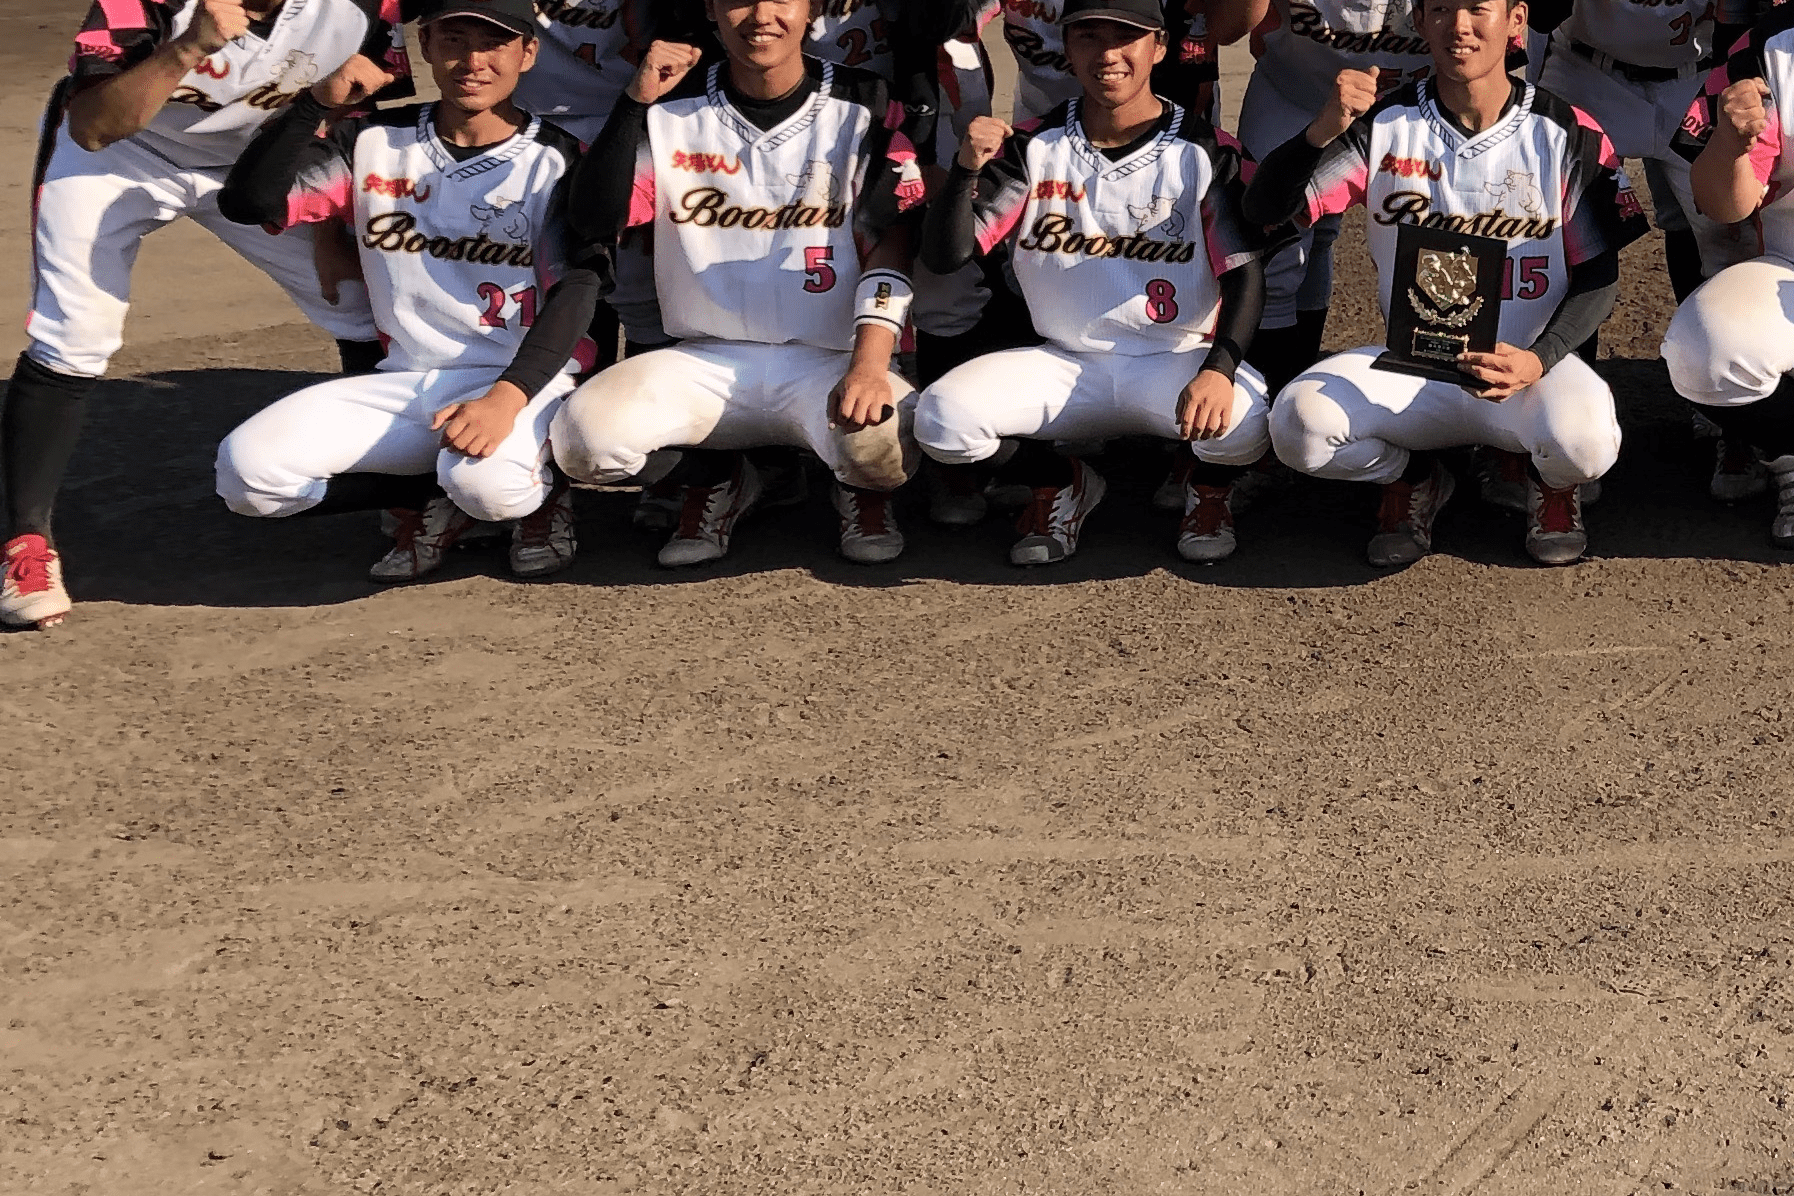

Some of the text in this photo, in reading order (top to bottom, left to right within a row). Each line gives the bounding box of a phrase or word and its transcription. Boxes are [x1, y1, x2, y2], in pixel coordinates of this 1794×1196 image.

[669, 186, 847, 230] Boostars
[1373, 189, 1559, 240] Boostars
[362, 210, 533, 268] Boostars
[1019, 213, 1197, 264] Boostars
[802, 245, 837, 294] 5
[1500, 255, 1550, 301] 15
[477, 281, 538, 331] 21
[1145, 278, 1178, 324] 8
